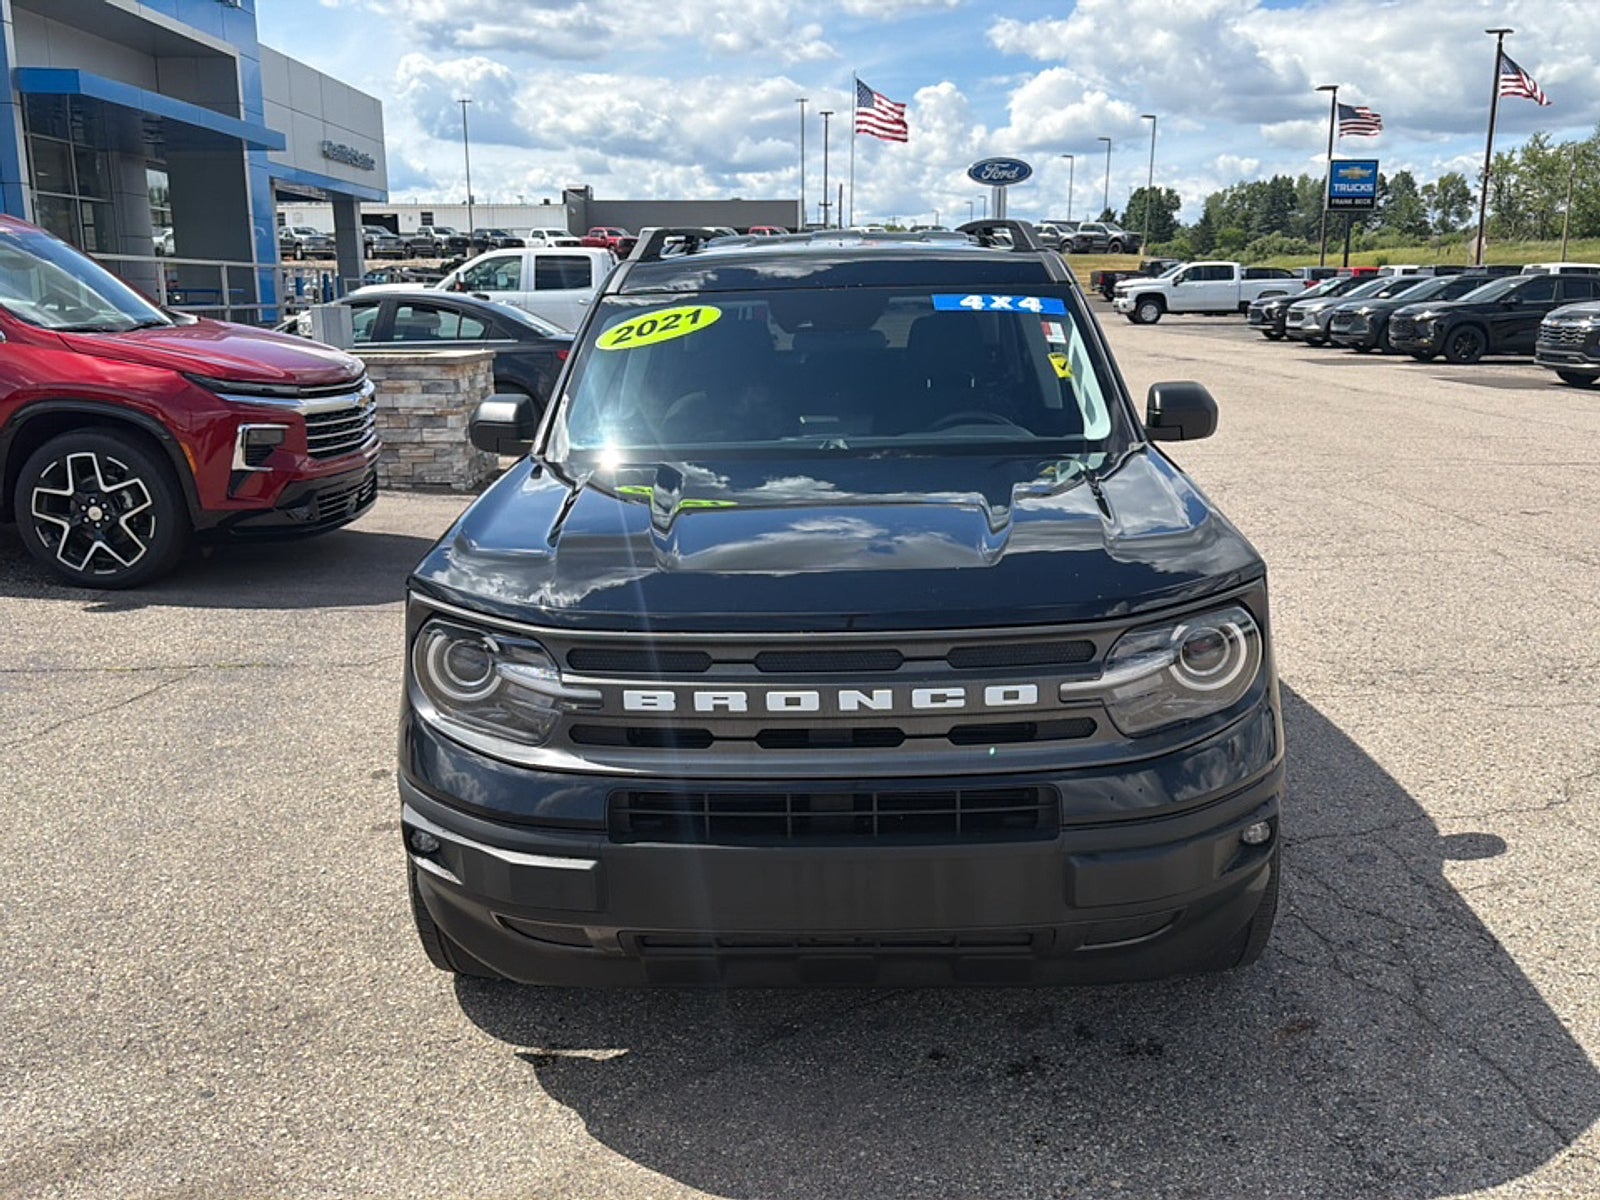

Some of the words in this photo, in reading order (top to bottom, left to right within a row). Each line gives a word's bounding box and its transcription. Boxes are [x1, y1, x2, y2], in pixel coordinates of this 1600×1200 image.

[981, 163, 1020, 180] Ford
[1333, 183, 1374, 193] TRUCKS
[611, 308, 702, 345] 2021
[623, 684, 1038, 711] BRONCO
